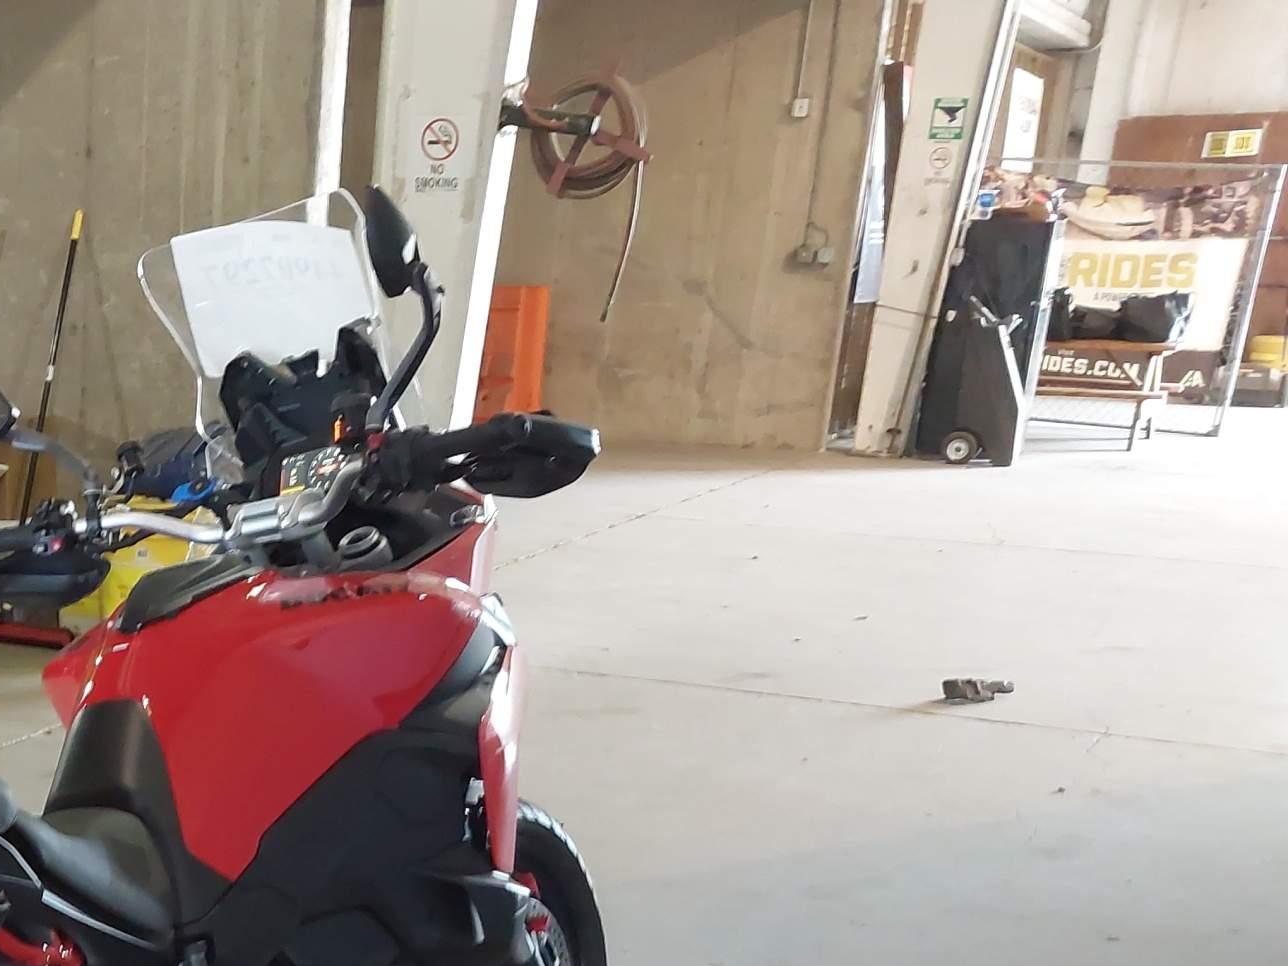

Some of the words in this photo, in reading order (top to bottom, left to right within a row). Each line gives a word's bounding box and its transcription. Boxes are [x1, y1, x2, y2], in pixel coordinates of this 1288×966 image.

[430, 163, 444, 175] NO
[414, 177, 458, 189] SMOKING
[1068, 252, 1198, 289] RIDES
